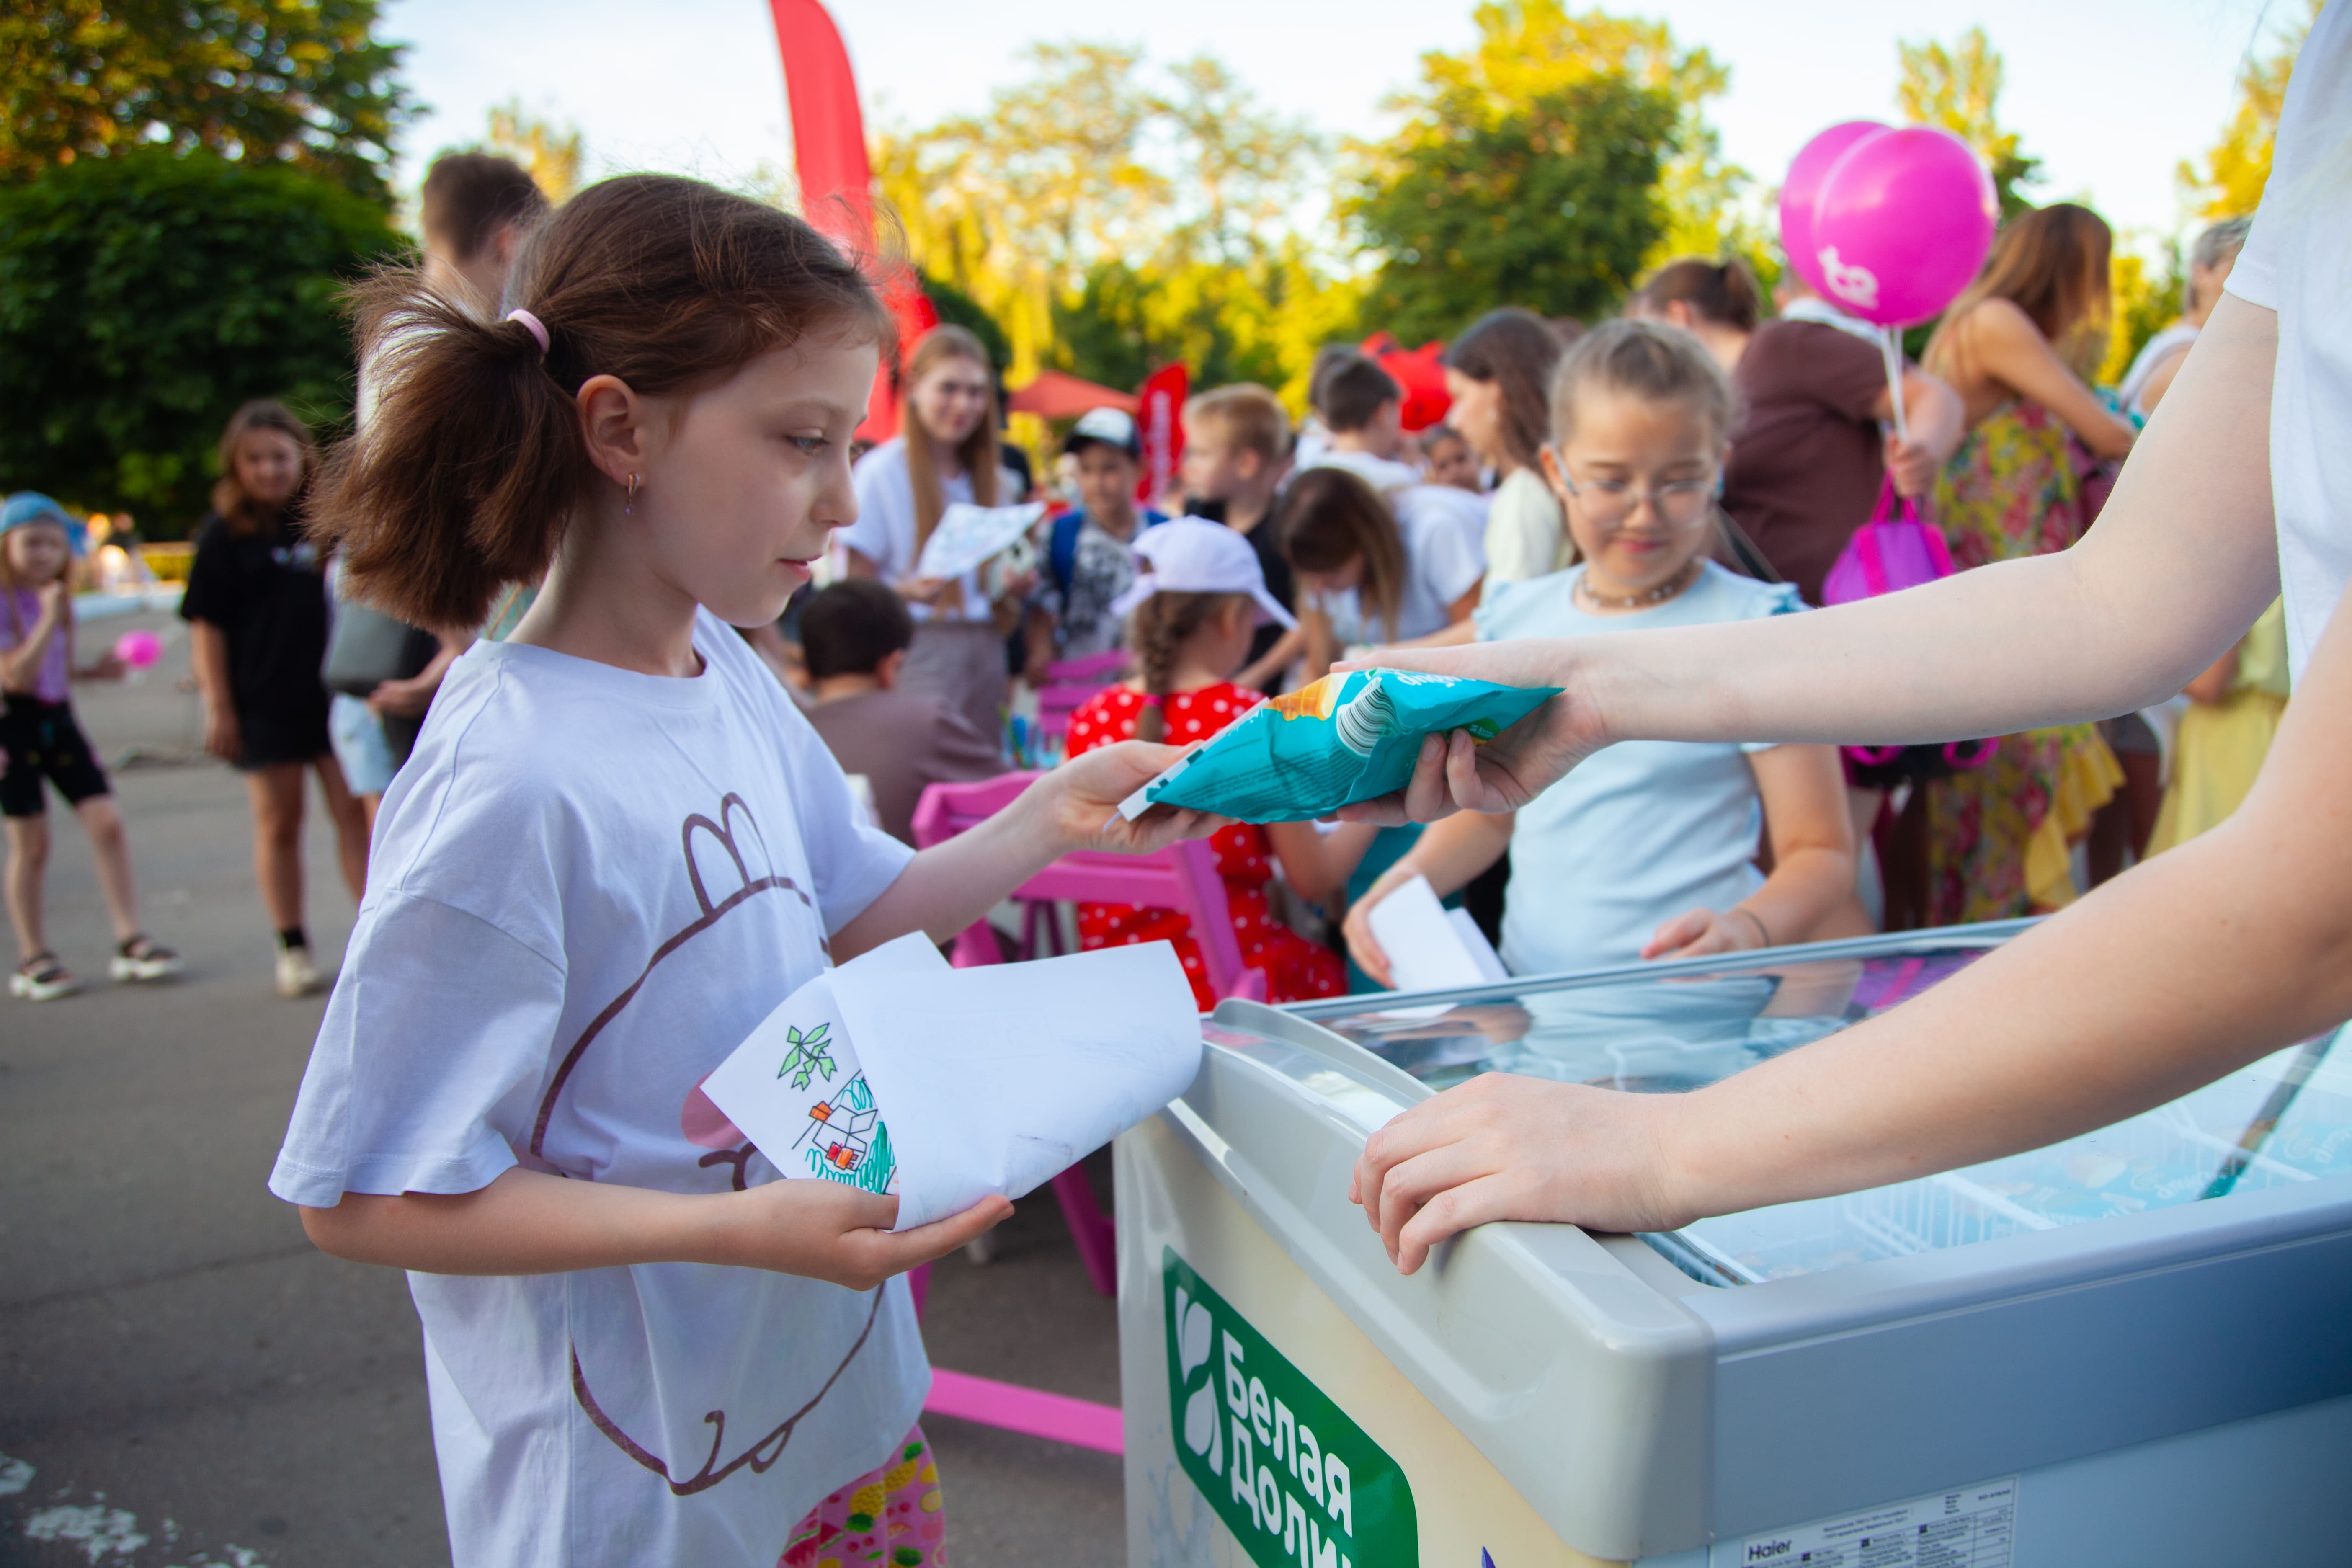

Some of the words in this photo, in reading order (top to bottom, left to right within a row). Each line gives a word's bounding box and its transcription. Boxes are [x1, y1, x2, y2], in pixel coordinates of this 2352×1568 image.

[1222, 1328, 1353, 1538] Белая
[1230, 1414, 1352, 1568] Доли
[1748, 1539, 1792, 1561] Haier
